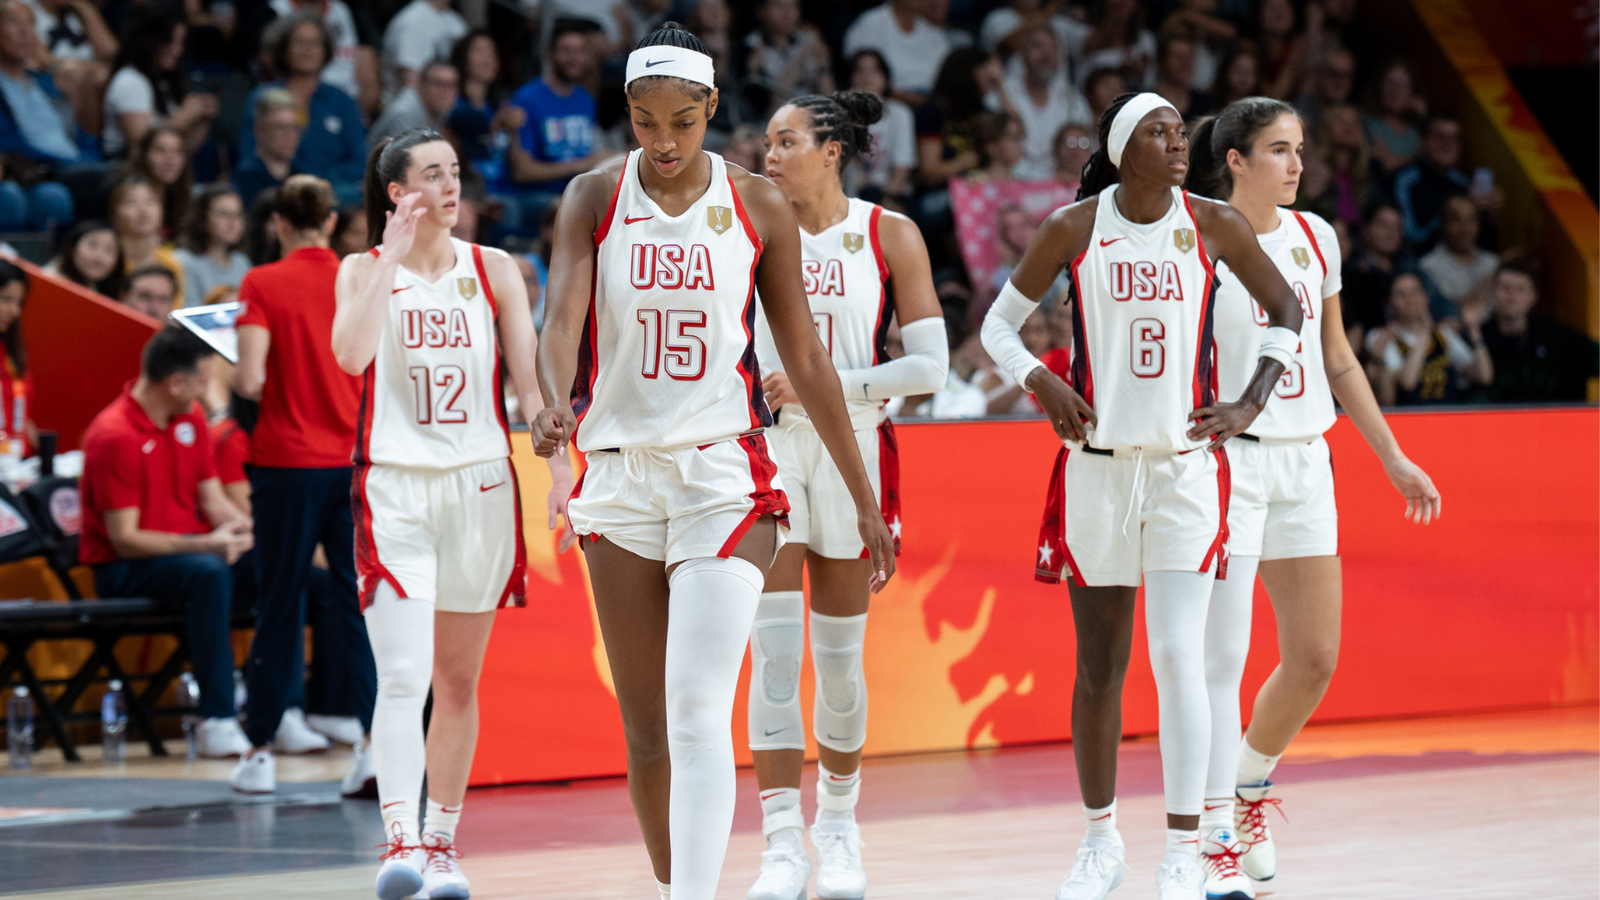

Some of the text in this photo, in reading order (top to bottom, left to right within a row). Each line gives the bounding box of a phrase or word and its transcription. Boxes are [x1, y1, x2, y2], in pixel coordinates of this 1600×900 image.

[630, 244, 715, 291] USA
[801, 259, 845, 296] SA
[1110, 261, 1184, 301] USA
[400, 308, 472, 349] USA
[637, 308, 707, 381] 15
[1130, 317, 1165, 378] 6
[409, 364, 468, 425] 12
